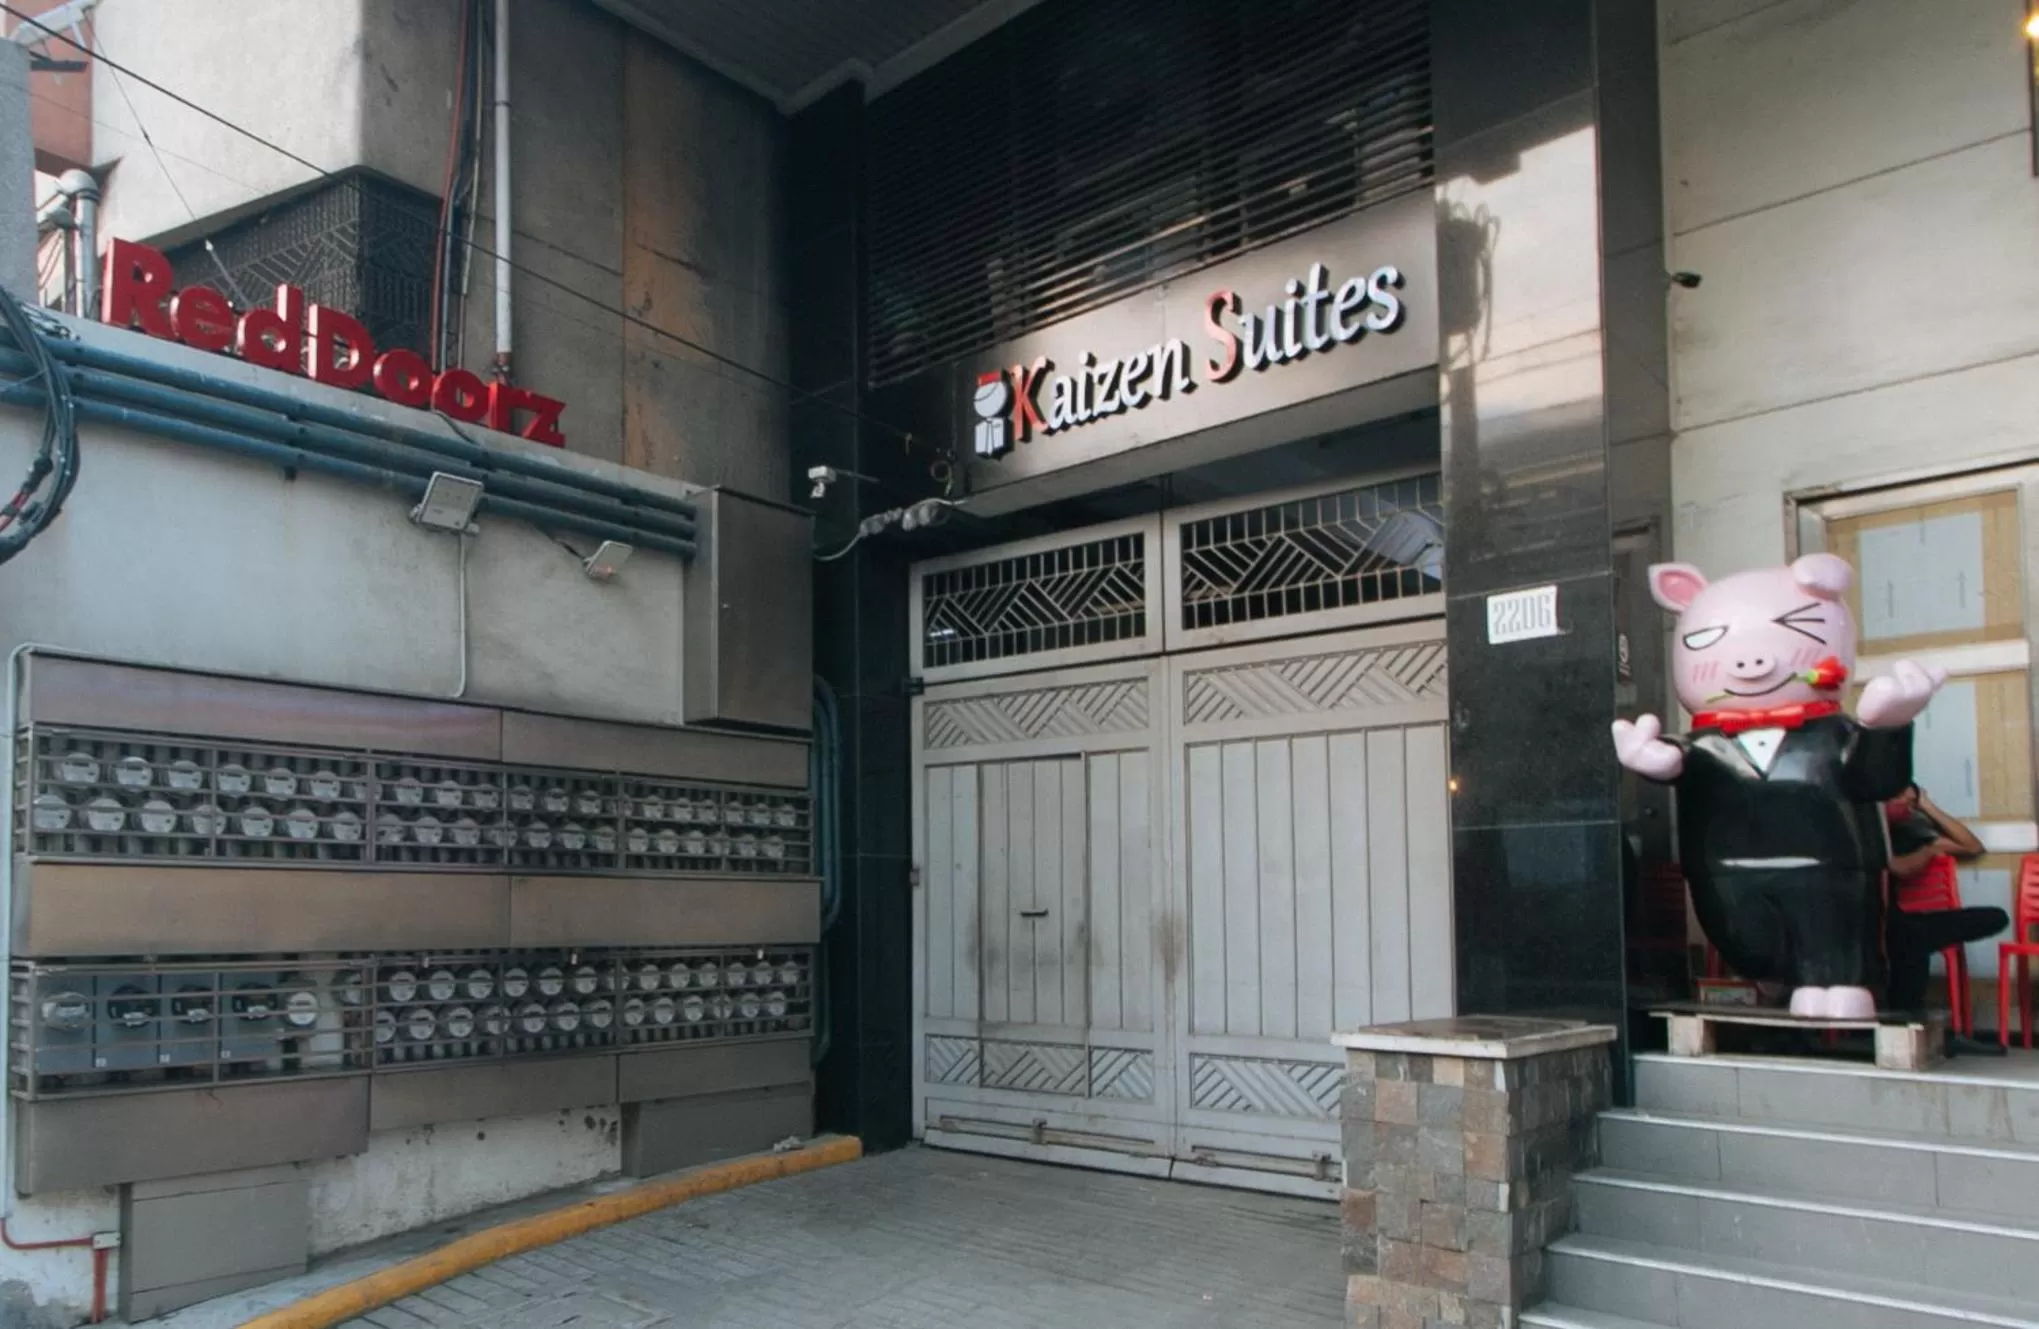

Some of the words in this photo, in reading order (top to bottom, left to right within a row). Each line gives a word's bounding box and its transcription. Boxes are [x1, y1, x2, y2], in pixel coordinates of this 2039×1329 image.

[101, 237, 566, 448] RedDoorz
[1011, 337, 1191, 441] Kaizen
[1204, 261, 1400, 381] Suites
[1492, 593, 1552, 635] 2206
